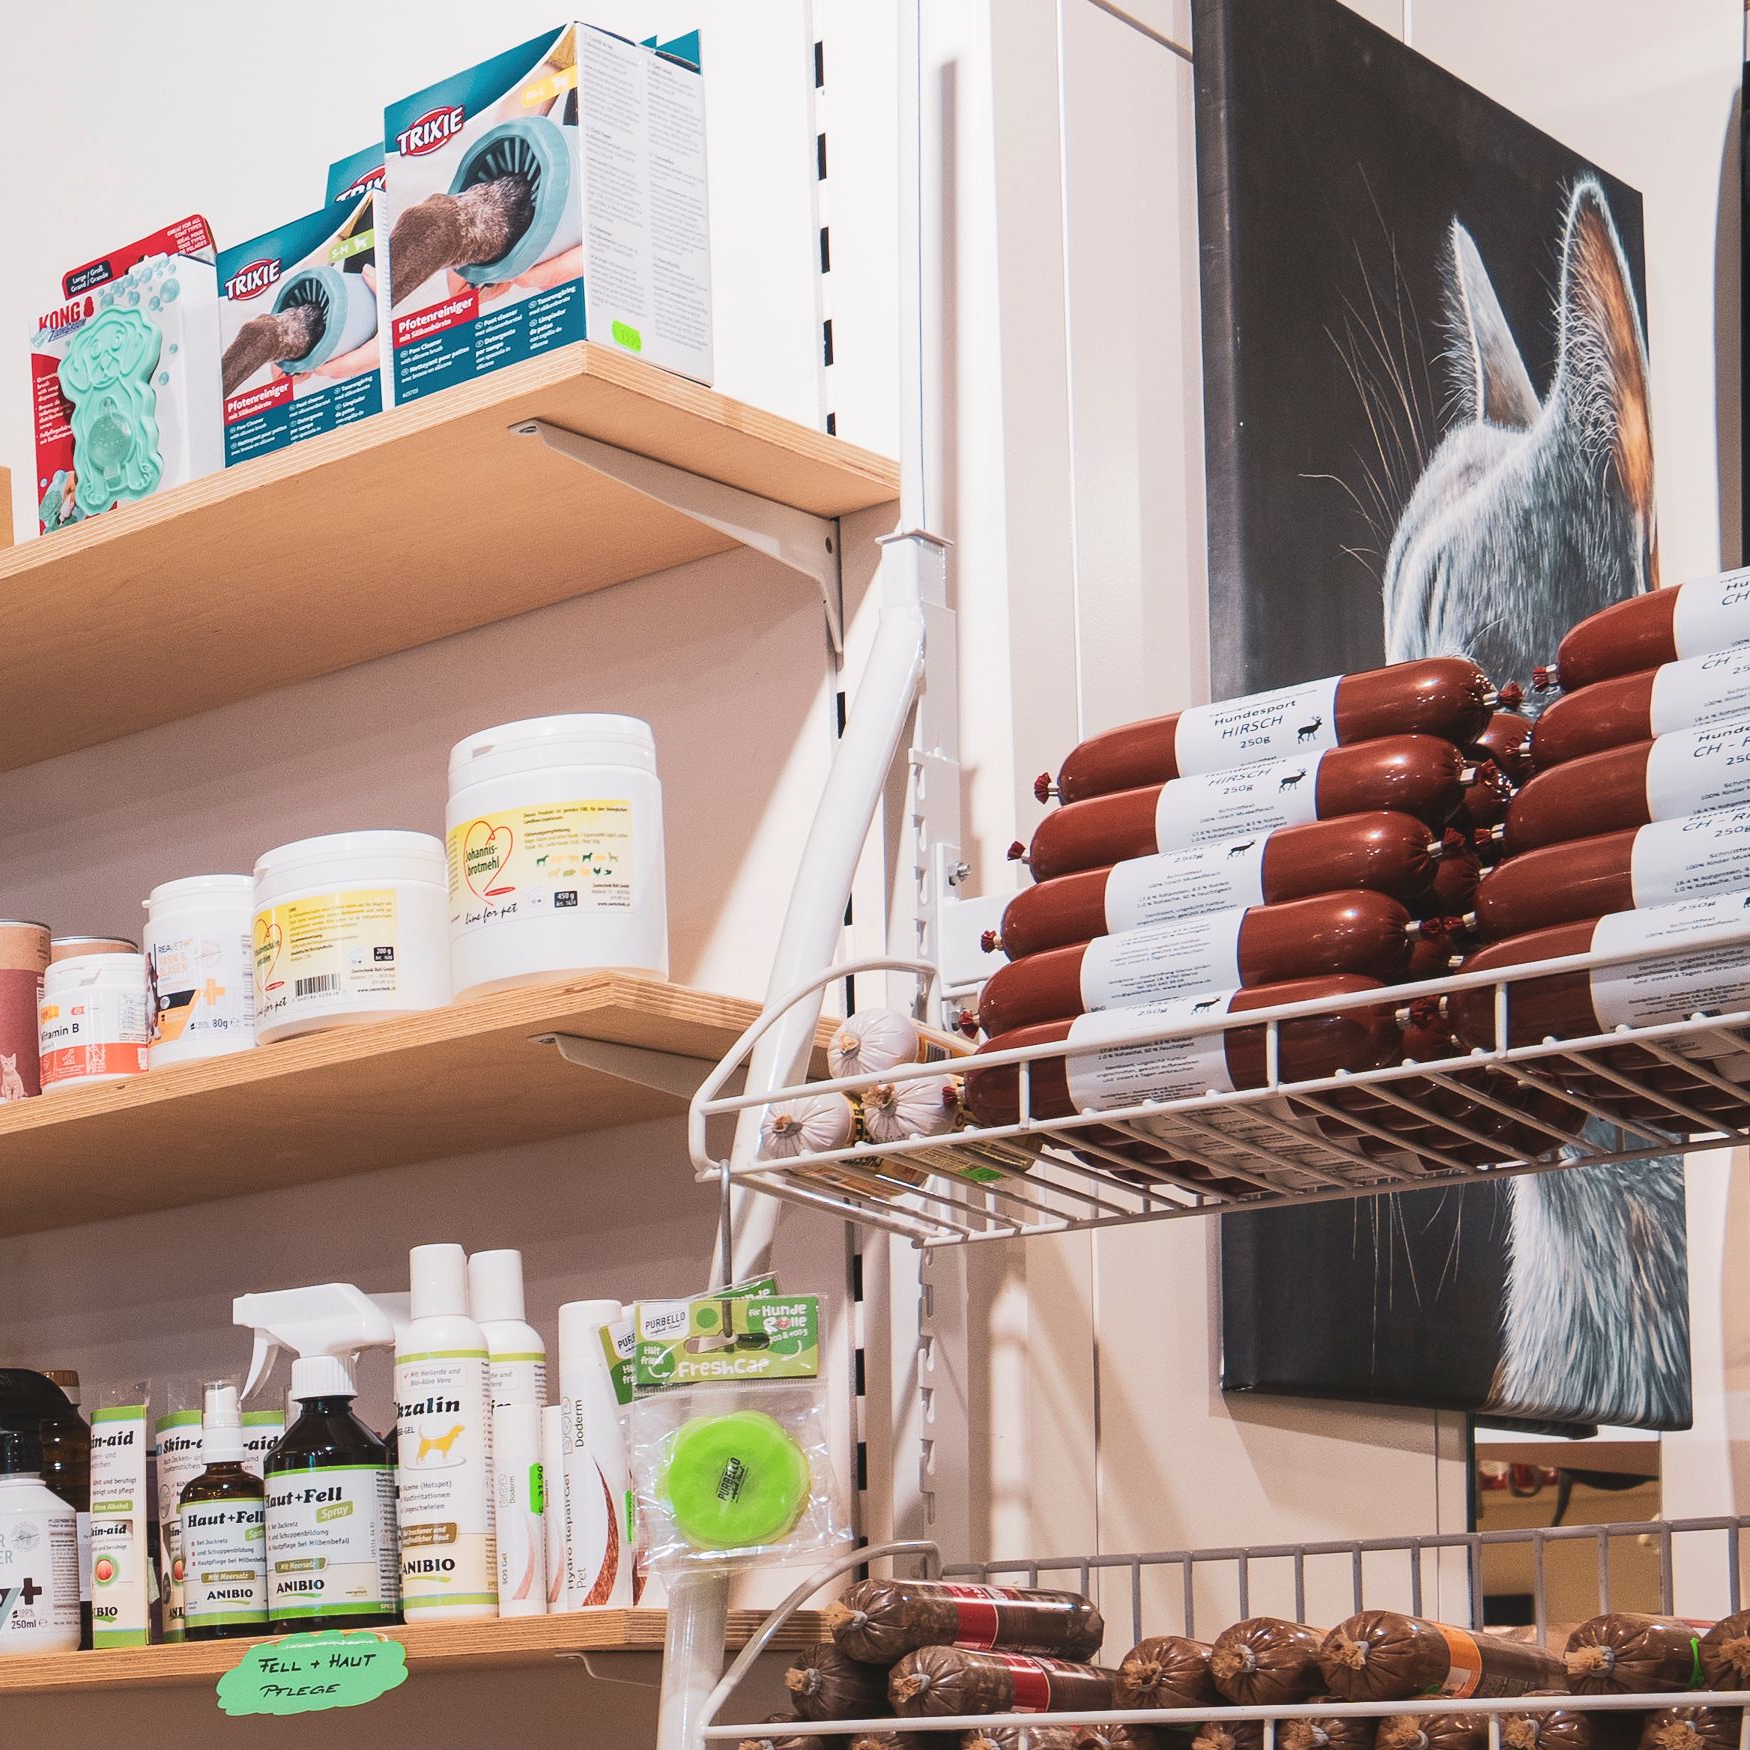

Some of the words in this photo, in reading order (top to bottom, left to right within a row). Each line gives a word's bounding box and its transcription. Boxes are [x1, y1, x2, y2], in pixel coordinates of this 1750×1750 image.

[397, 106, 464, 155] TRIXIE
[225, 258, 281, 299] TRIXIE
[38, 300, 81, 331] KONG
[398, 297, 474, 333] Pfotenreiniger
[226, 382, 290, 413] Pfotenreiniger
[1214, 700, 1297, 727] Hundesport
[1221, 715, 1284, 740] HIRSCH
[1239, 735, 1271, 750] 250g
[465, 843, 498, 863] Johannis-
[466, 857, 500, 878] brotmehl
[645, 1311, 686, 1330] PURBELLO
[762, 1303, 806, 1316] Hunde
[678, 1357, 770, 1378] FreshCap
[574, 1399, 585, 1448] Doderm
[320, 1504, 349, 1518] Spray
[576, 1567, 587, 1589] Pet
[11, 1619, 37, 1631] 250ml
[258, 1658, 305, 1675] FELL
[329, 1653, 377, 1669] HAUT
